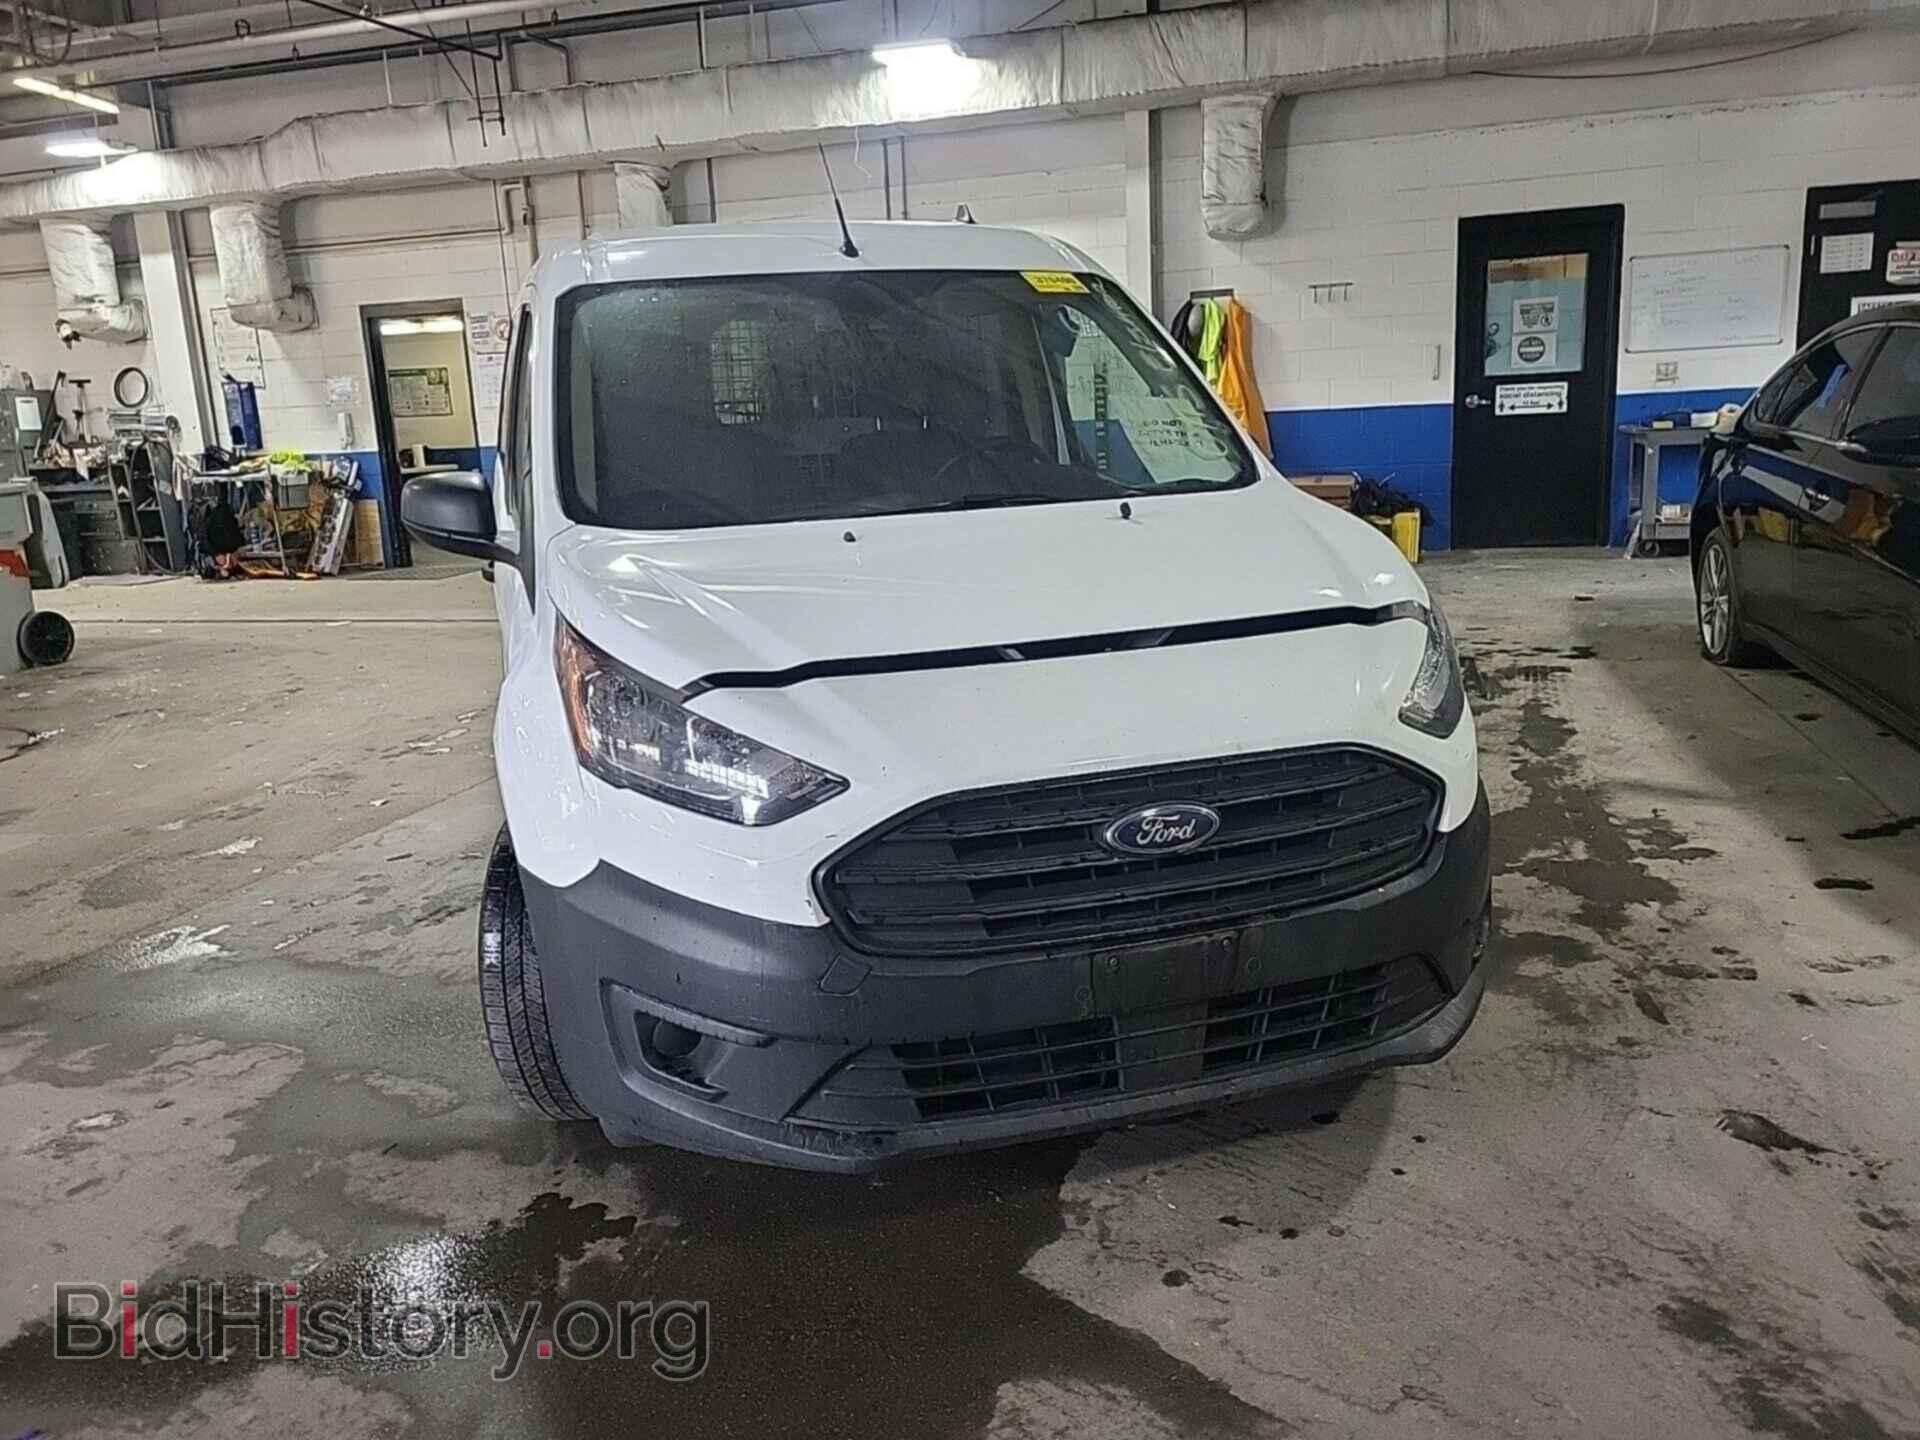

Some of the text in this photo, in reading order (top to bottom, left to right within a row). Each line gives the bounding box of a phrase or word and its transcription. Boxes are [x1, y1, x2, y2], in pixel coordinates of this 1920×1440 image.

[1499, 390, 1562, 399] social distancing
[1135, 814, 1196, 845] Ford
